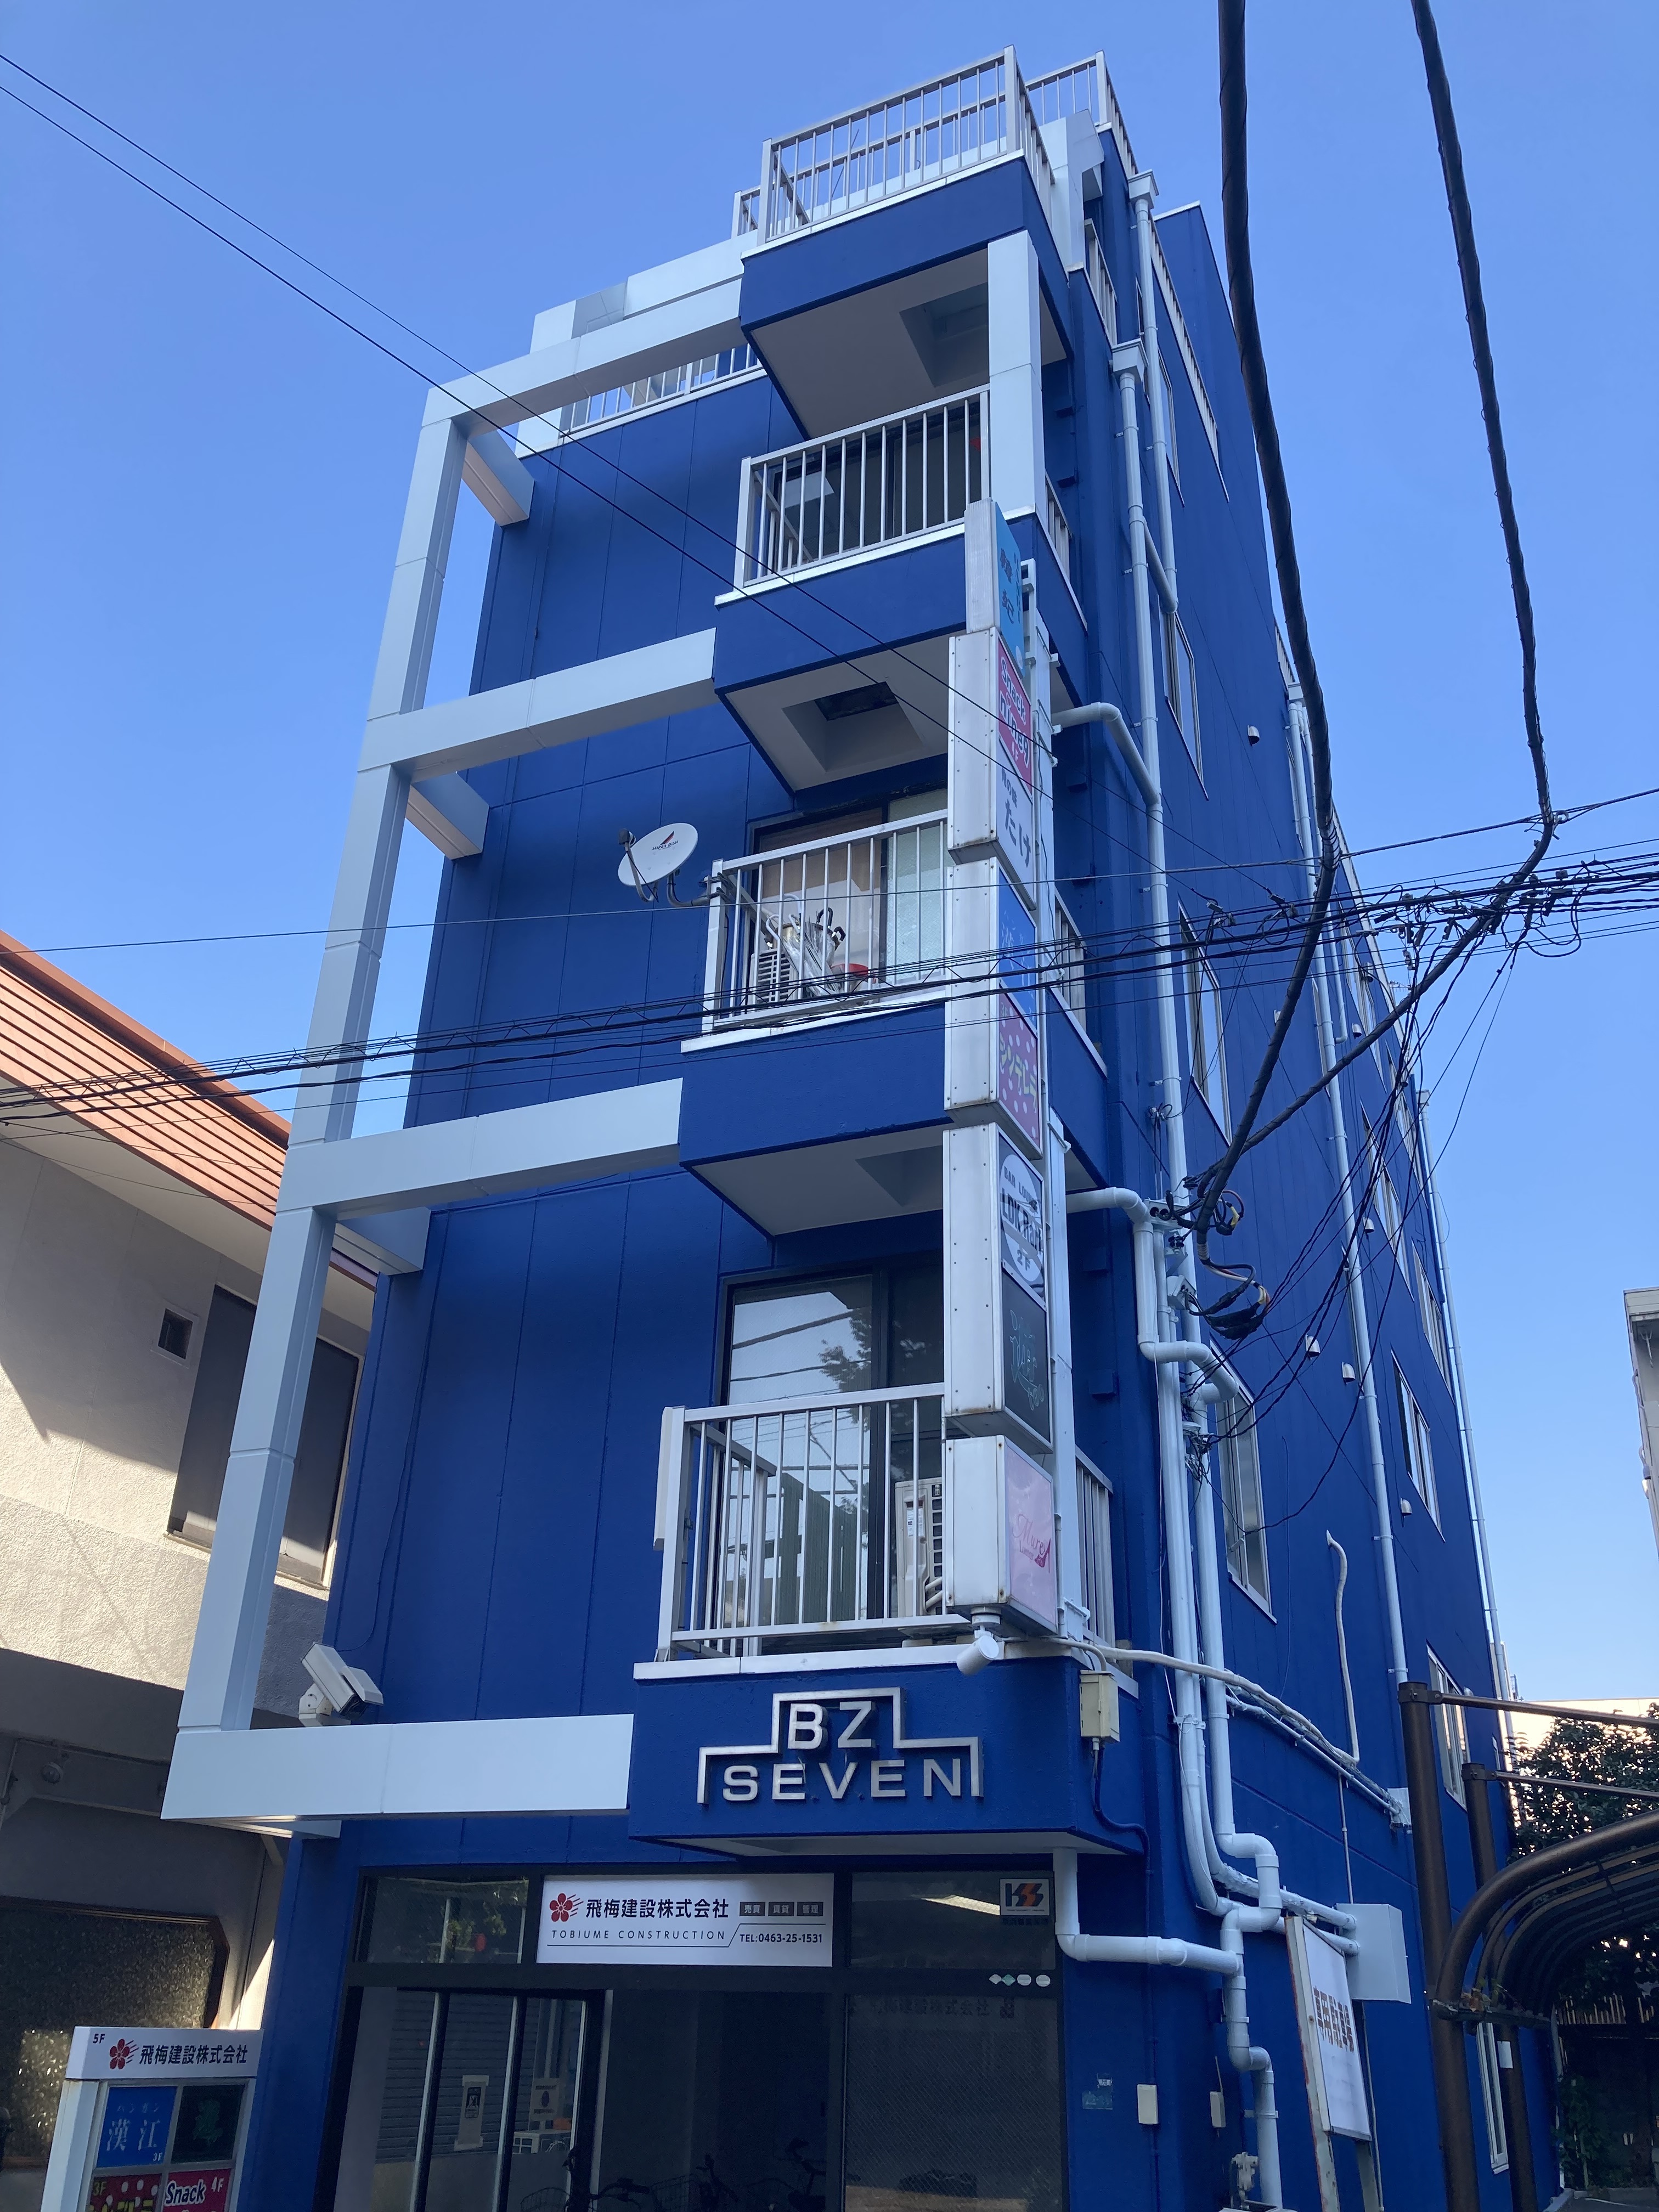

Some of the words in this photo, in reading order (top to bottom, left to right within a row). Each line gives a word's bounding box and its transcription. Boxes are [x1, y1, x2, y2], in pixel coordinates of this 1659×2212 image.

[1002, 659, 1025, 723] Snack
[1005, 799, 1031, 868] たけ
[1004, 1165, 1015, 1188] BAR
[1017, 1249, 1031, 1271] 2F
[787, 1701, 876, 1750] BZ
[722, 1758, 961, 1802] SEVEN
[585, 1898, 729, 1919] 飛梅建設株式会社
[551, 1929, 610, 1939] TOBIUME
[618, 1930, 725, 1940] CONSTRUCTION
[740, 1933, 822, 1943] TEL:0463-25-1531
[93, 2033, 105, 2044] 5F
[139, 2045, 248, 2065] 飛梅建設株式会社
[153, 2152, 163, 2162] 3F
[166, 2180, 206, 2204] Snack
